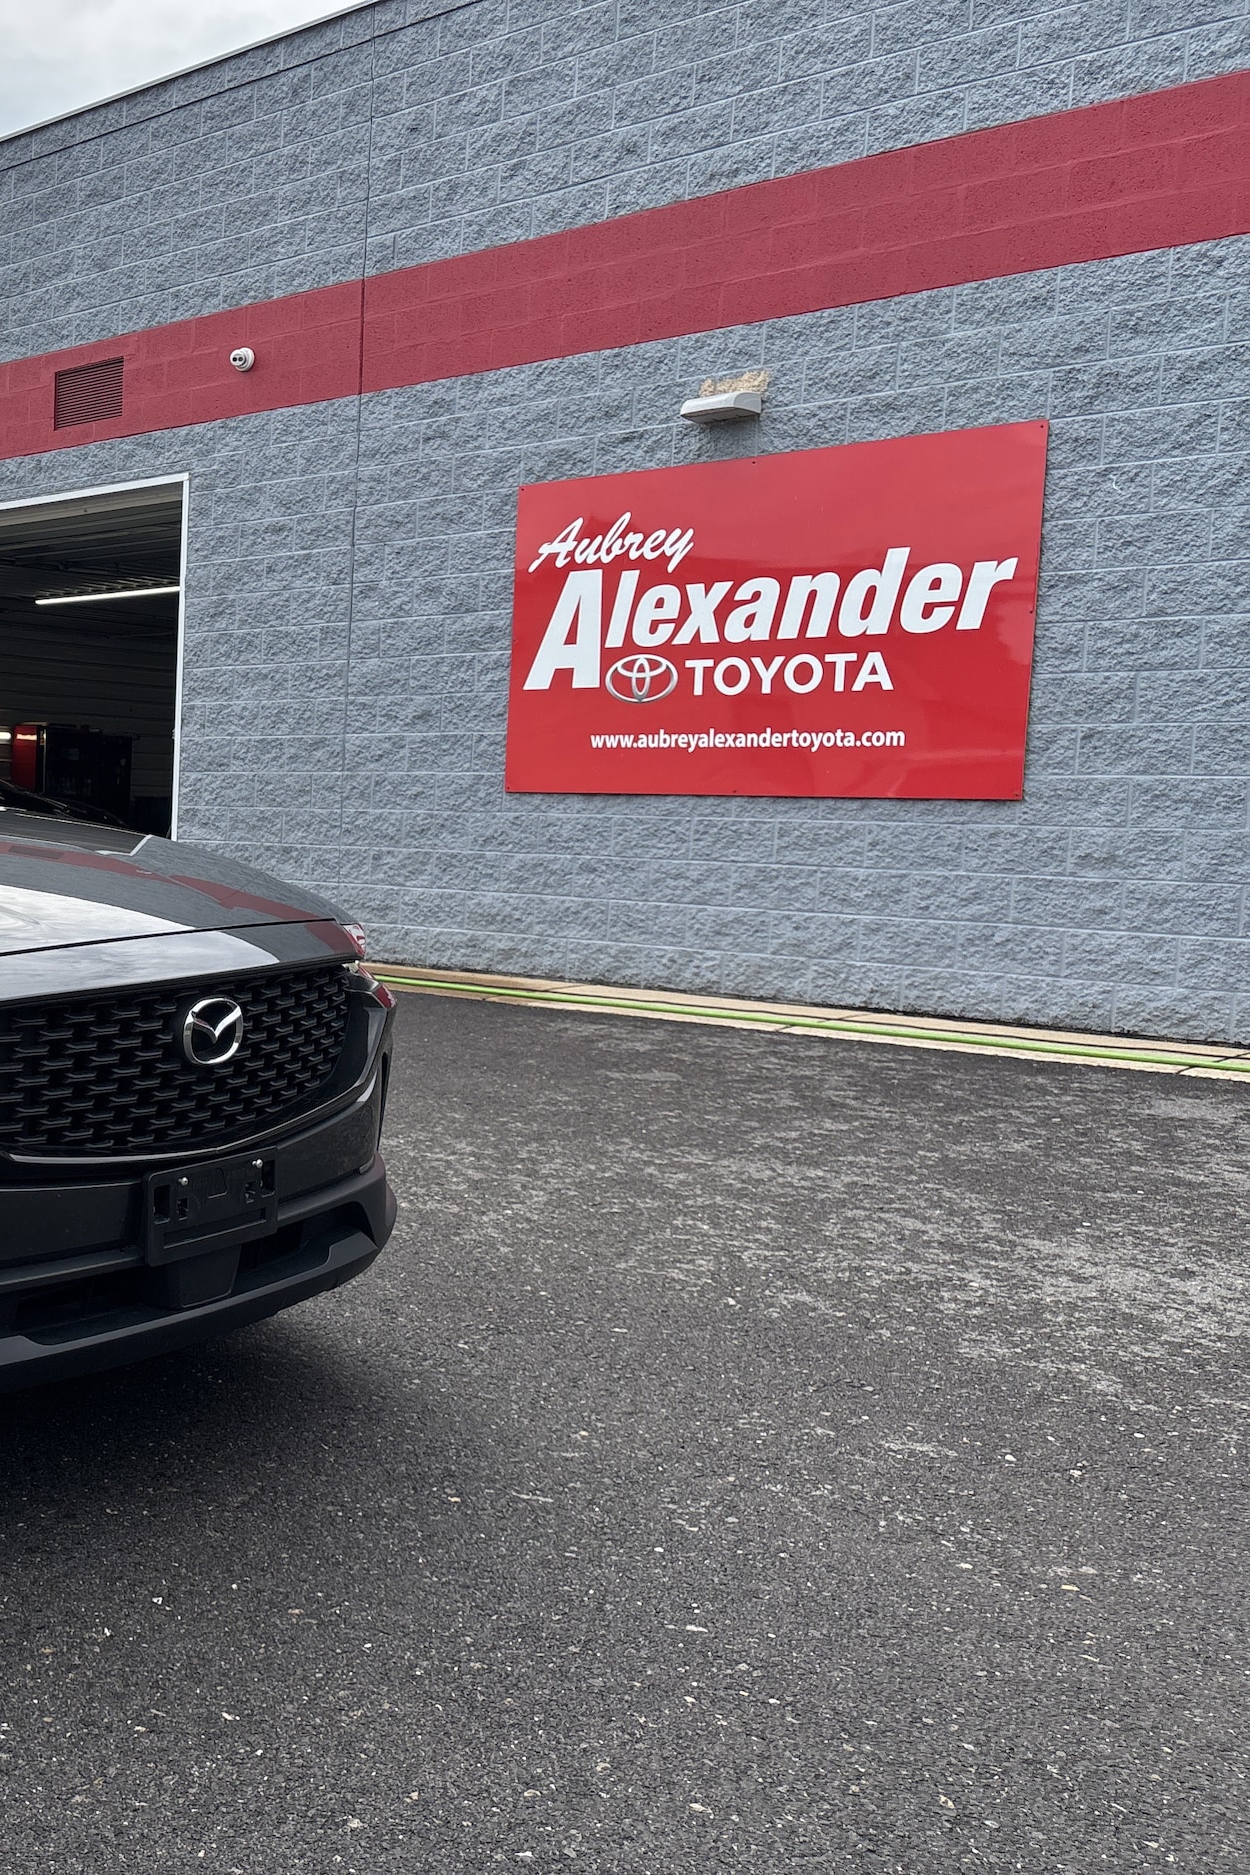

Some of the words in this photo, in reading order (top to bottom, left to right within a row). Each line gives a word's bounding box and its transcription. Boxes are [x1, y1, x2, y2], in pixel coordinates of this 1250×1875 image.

[527, 511, 694, 574] Aubrey
[522, 546, 1019, 691] Alexander
[684, 652, 894, 696] TOYOTA
[590, 727, 906, 753] www.aubreyalexandertoyota.com
